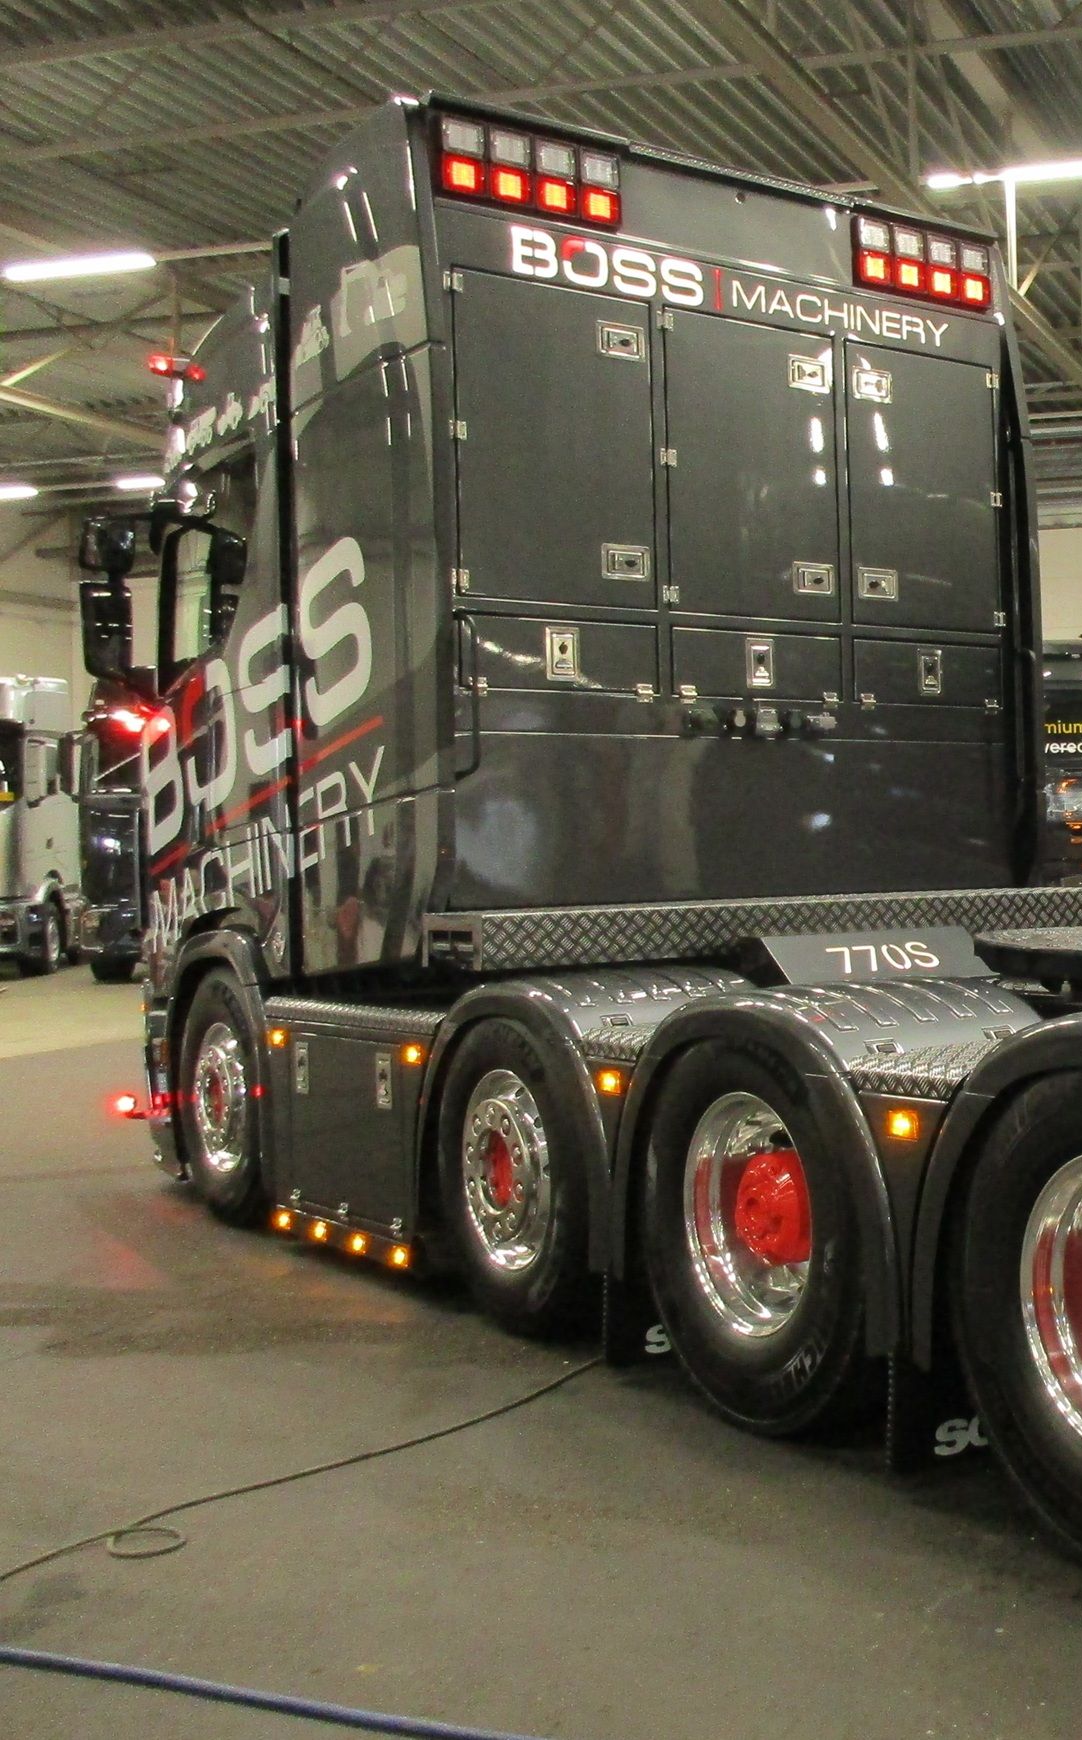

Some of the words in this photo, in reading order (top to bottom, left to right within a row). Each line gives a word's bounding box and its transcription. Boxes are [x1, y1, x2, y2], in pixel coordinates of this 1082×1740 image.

[511, 225, 704, 306] BOSS
[731, 280, 949, 347] MACHINERY
[825, 941, 940, 974] 770S
